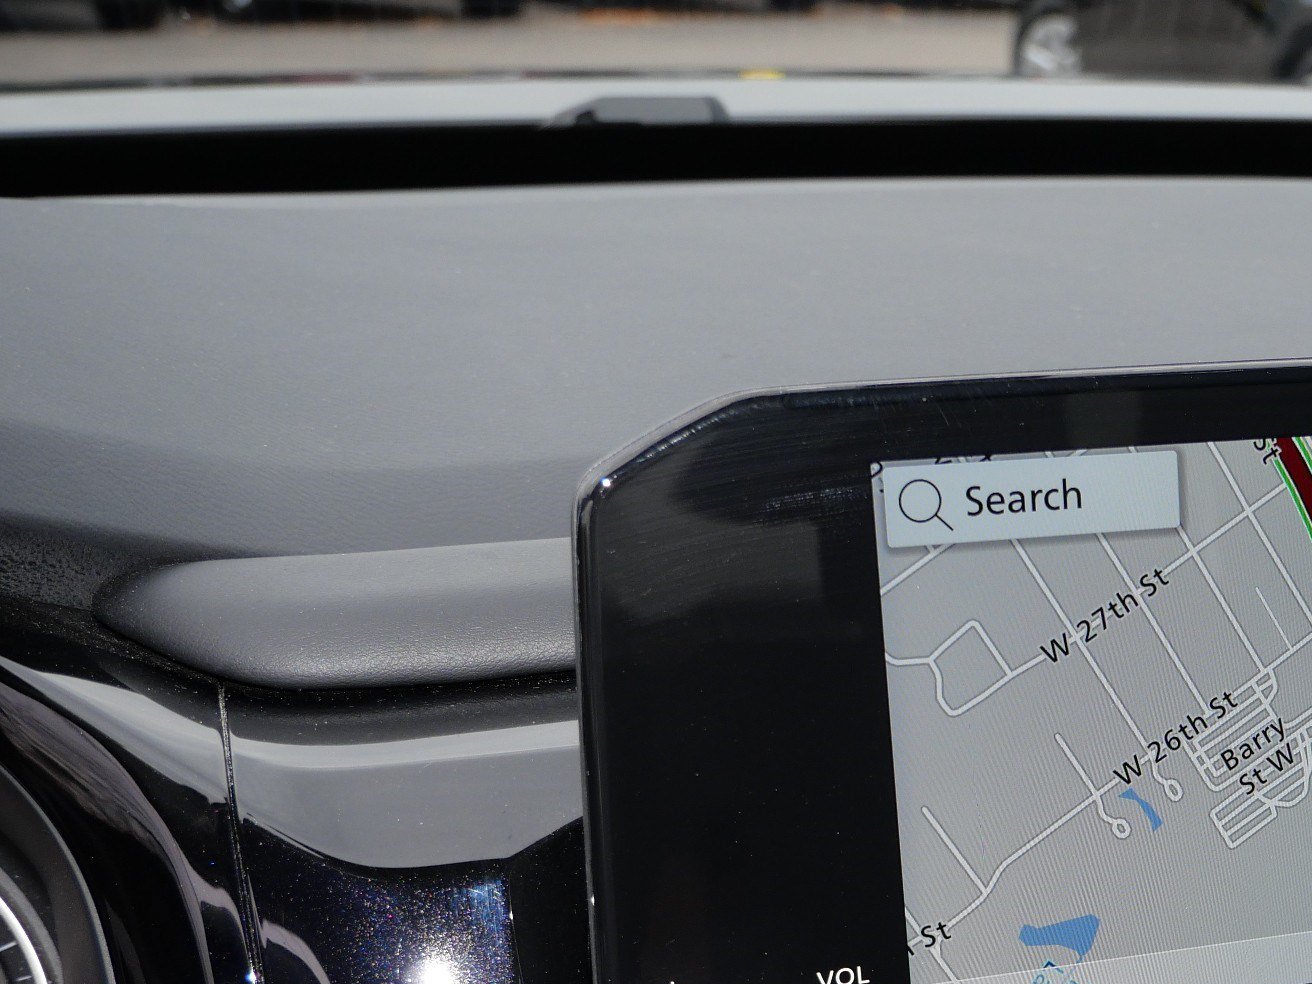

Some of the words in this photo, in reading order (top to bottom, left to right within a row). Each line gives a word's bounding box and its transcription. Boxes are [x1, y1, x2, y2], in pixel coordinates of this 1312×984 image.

[966, 477, 1083, 517] Search
[1040, 633, 1071, 665] W
[1076, 588, 1139, 643] 27th
[1139, 567, 1169, 598] St
[1113, 754, 1143, 785] W
[1147, 711, 1209, 764] 26th
[1208, 690, 1239, 721] St
[1219, 717, 1287, 772] Barry
[1238, 765, 1267, 796] St
[1265, 742, 1297, 773] W
[920, 922, 952, 948] St
